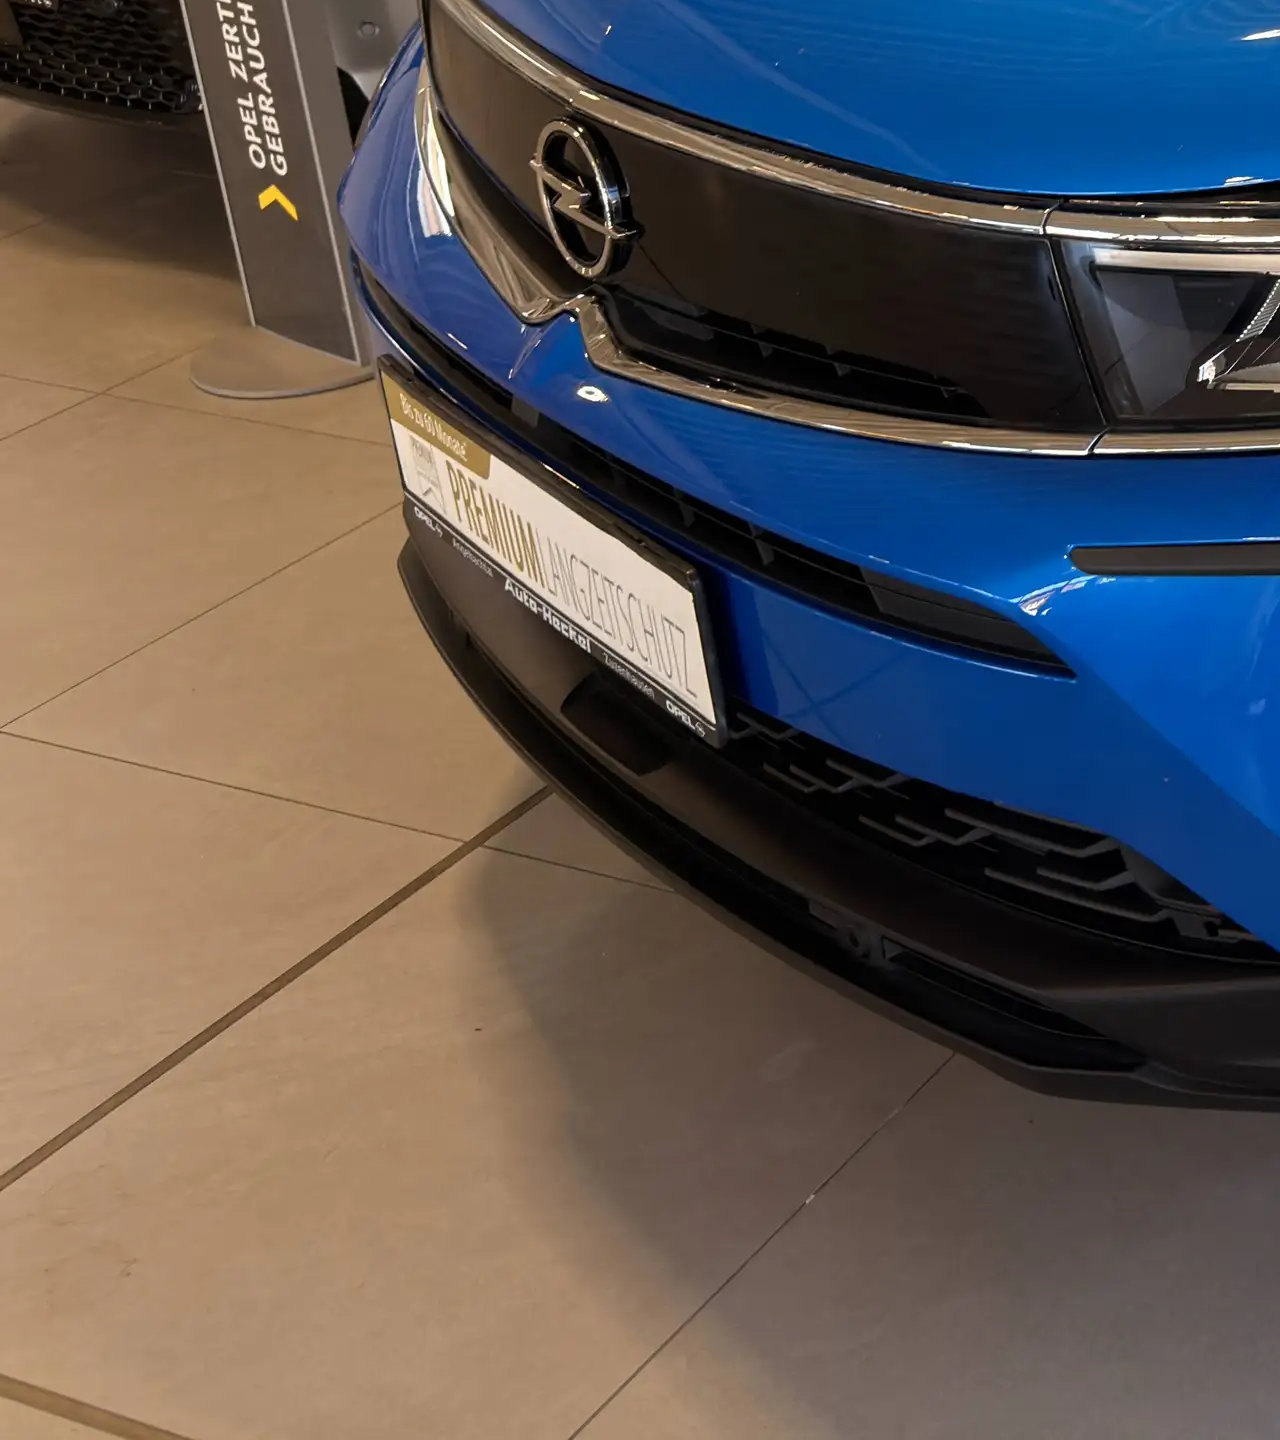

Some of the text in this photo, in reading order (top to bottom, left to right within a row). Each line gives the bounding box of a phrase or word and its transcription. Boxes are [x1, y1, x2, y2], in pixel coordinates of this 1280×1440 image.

[238, 92, 265, 170] OPEL
[414, 506, 437, 531] OPEL
[504, 578, 592, 653] Auto-Heckel
[666, 700, 697, 730] OPEL
